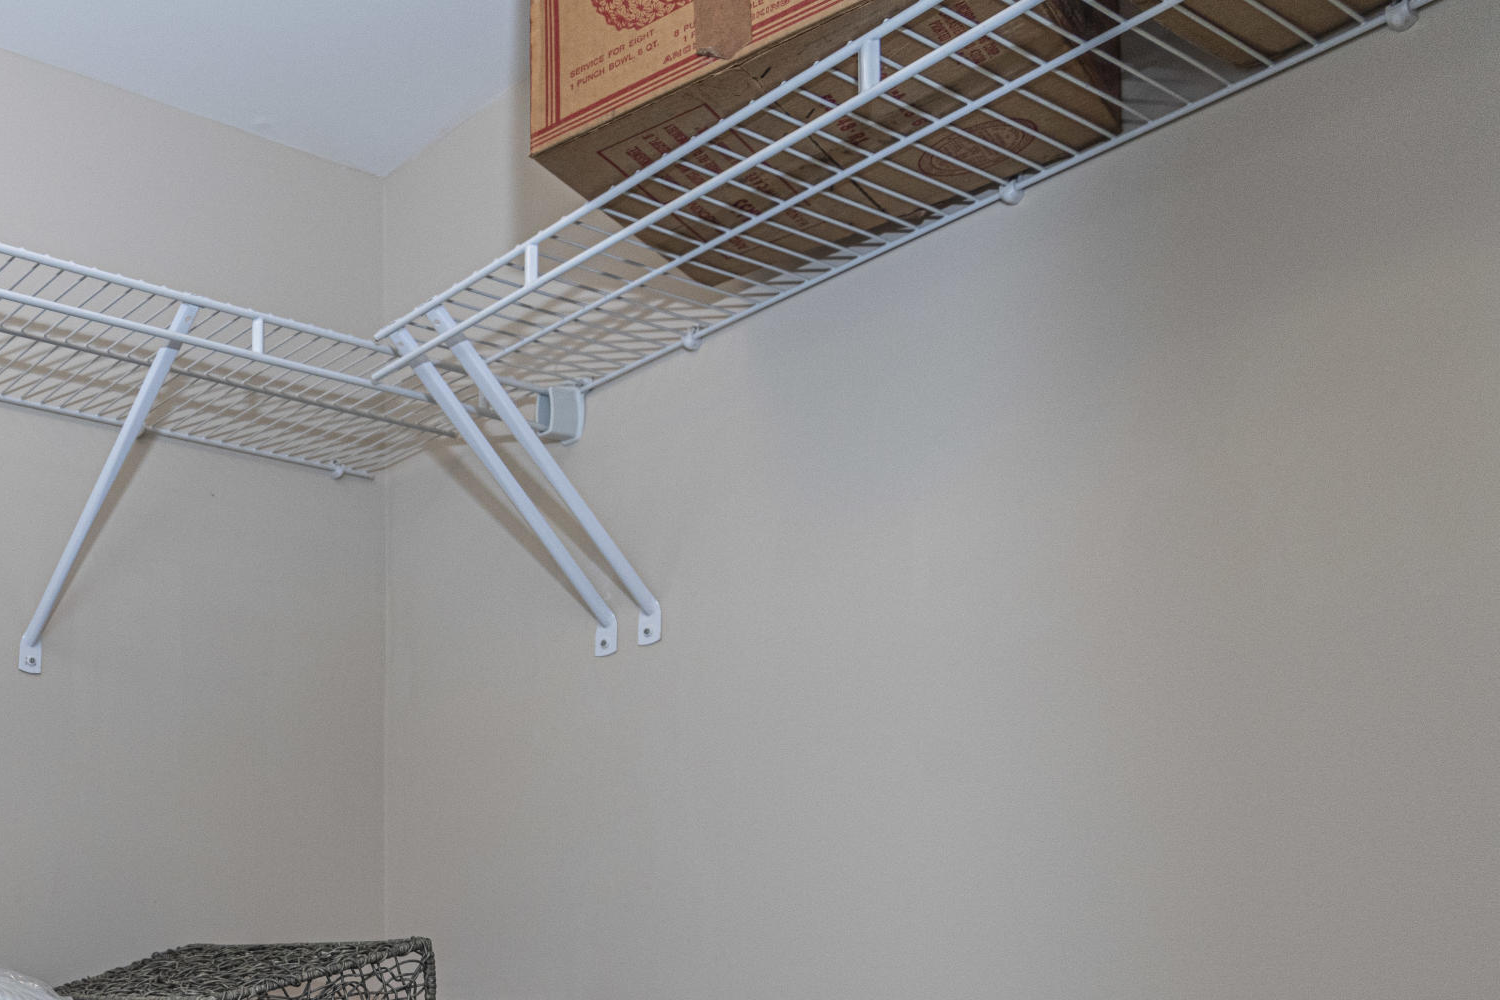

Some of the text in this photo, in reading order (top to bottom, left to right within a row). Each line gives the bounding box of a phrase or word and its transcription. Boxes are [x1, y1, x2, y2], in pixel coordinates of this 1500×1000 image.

[569, 29, 655, 78] SERVICE FOR EIGHT
[576, 68, 605, 87] PUNCH
